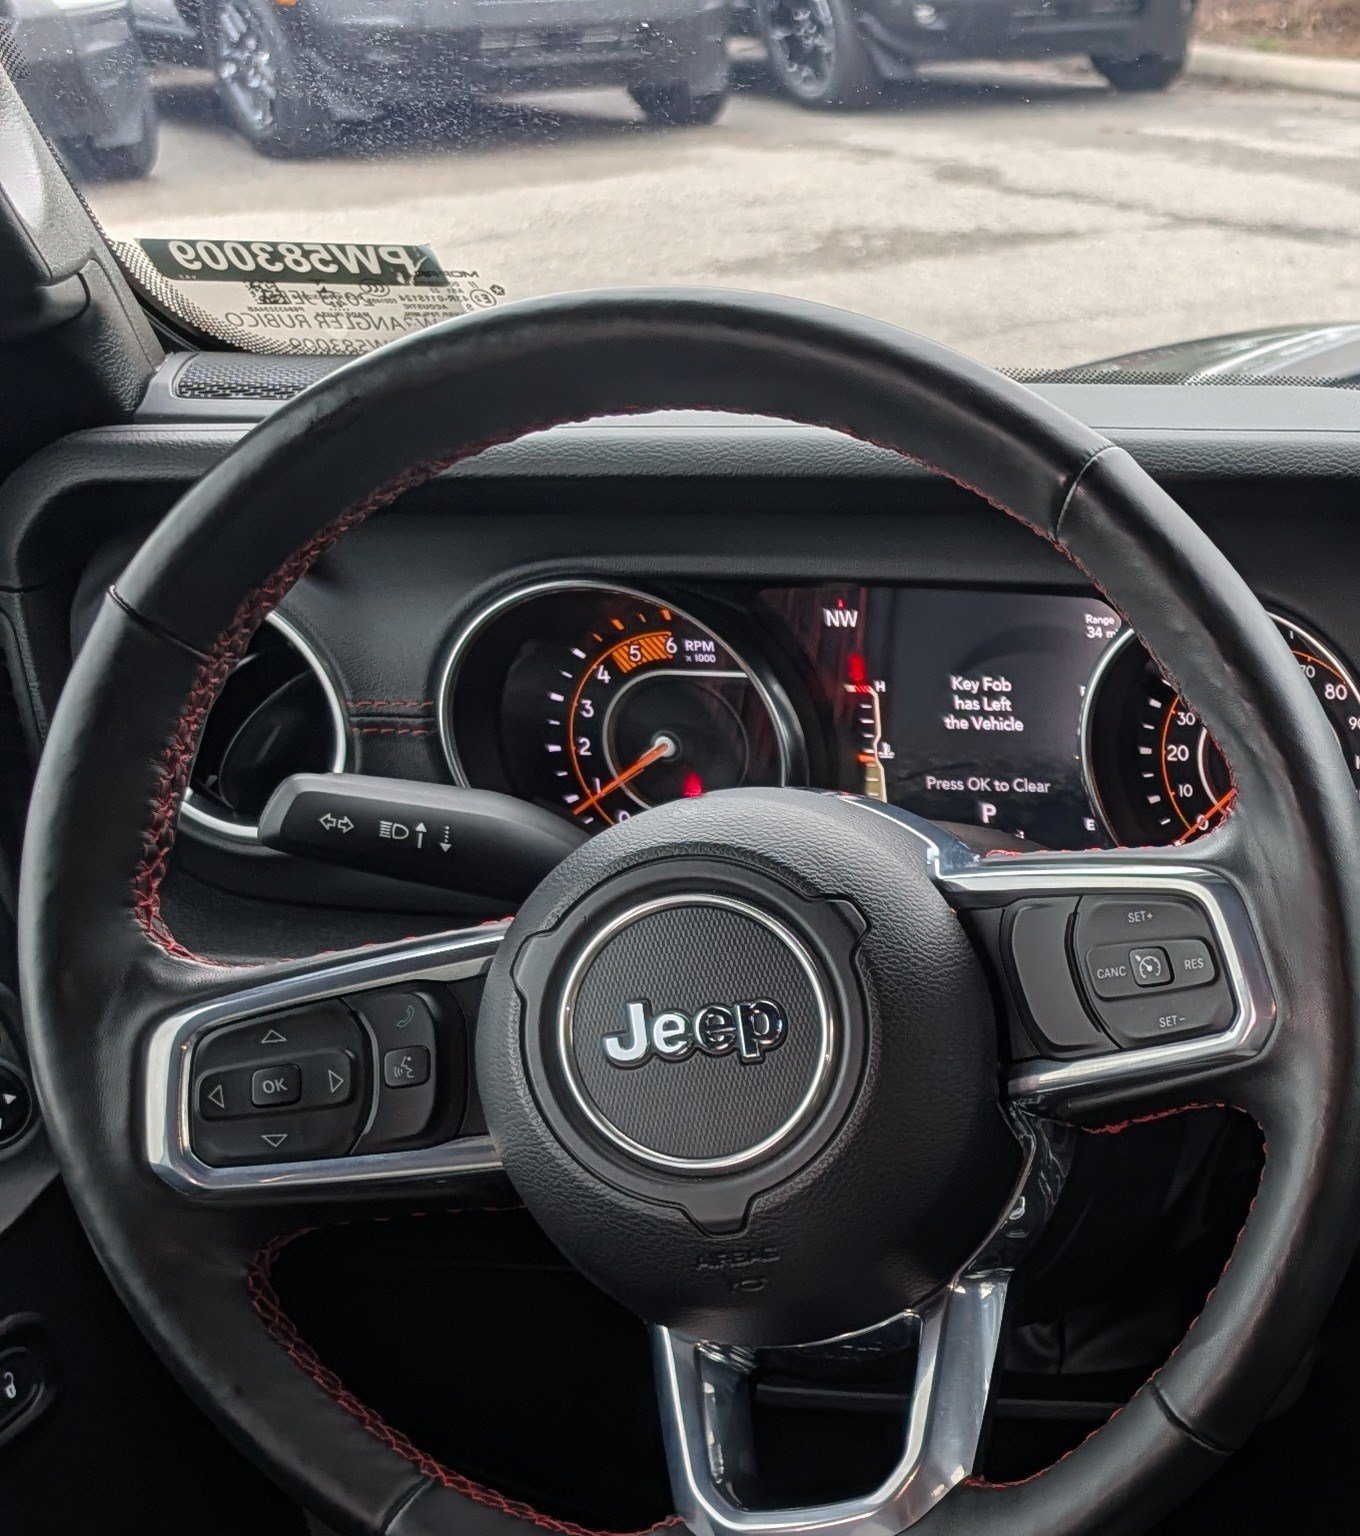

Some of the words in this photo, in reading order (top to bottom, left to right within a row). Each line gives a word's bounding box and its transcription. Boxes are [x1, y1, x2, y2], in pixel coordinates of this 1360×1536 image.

[823, 609, 859, 628] NW
[1084, 614, 1115, 626] Range
[1086, 626, 1103, 639] 34
[629, 645, 641, 663] 5
[666, 637, 678, 654] 6
[684, 640, 715, 653] RPM
[694, 654, 716, 663] 1000
[596, 665, 611, 684] 4
[874, 680, 886, 693] H
[951, 676, 979, 696] Key
[981, 676, 1012, 692] Fob
[1324, 683, 1348, 700] 80
[580, 700, 594, 718] 3
[954, 695, 979, 711] has
[982, 694, 1012, 712] Left
[944, 715, 970, 731] the
[972, 715, 1024, 733] Vehicle
[1177, 712, 1196, 726] 30
[579, 738, 591, 756] 2
[1166, 744, 1189, 761] 20
[926, 775, 965, 791] Press
[967, 776, 991, 792] OK
[994, 779, 1010, 792] to
[1012, 777, 1051, 793] Clear
[1178, 783, 1193, 798] 10
[981, 803, 997, 824] P
[1084, 818, 1096, 831] E
[1096, 965, 1127, 980] CANC
[1183, 957, 1204, 971] RES
[603, 1000, 787, 1065] Jeep
[262, 1076, 288, 1095] OK
